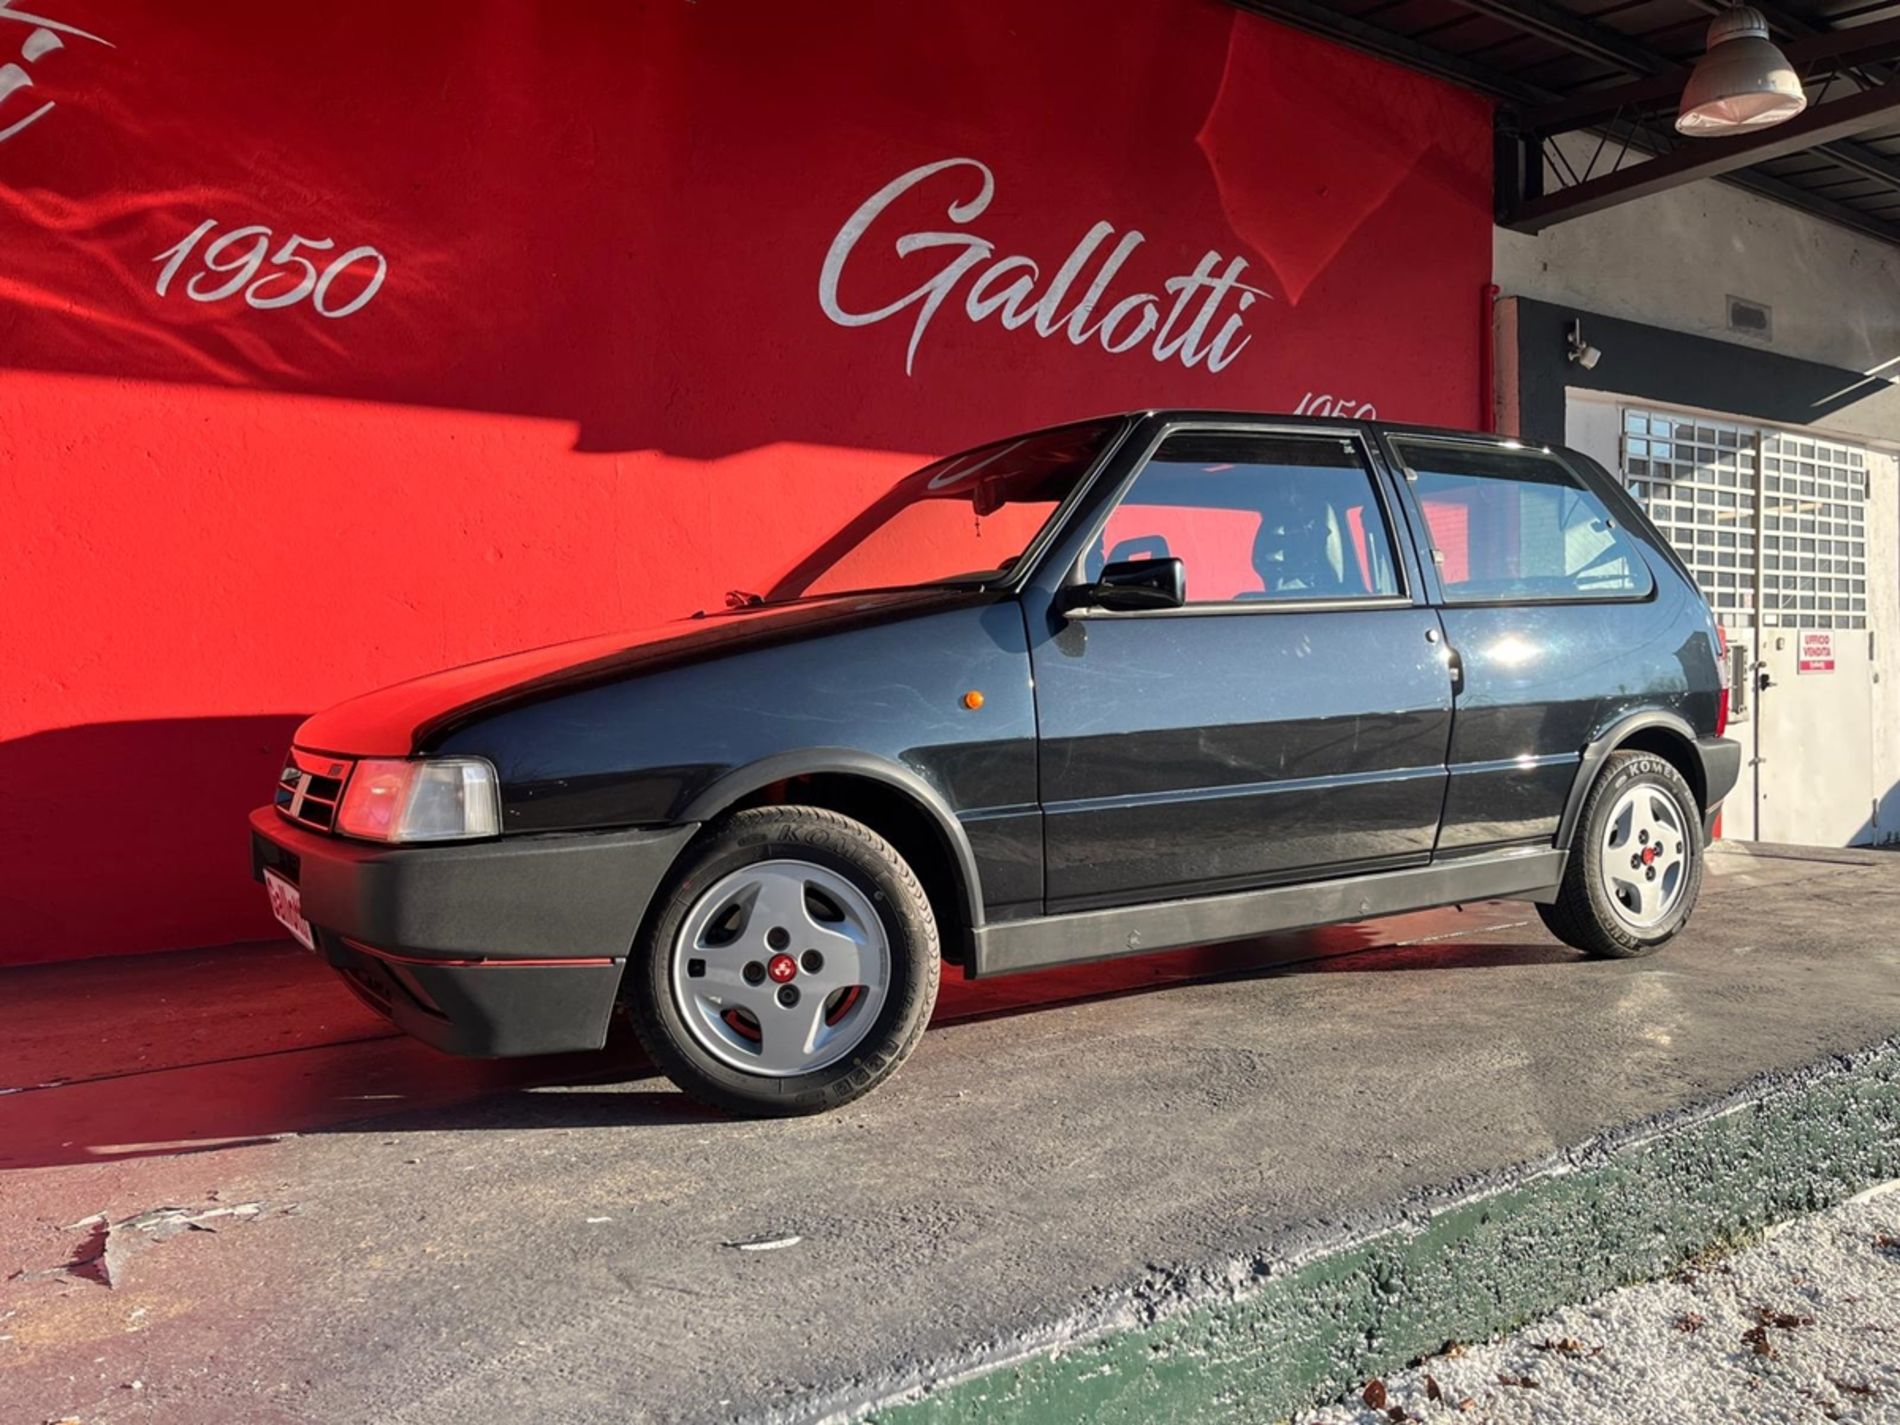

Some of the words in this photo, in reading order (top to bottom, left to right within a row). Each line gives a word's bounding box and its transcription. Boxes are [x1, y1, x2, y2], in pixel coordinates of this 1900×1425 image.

[152, 219, 387, 318] 1950
[819, 157, 1274, 376] Gallotti
[1629, 760, 1680, 782] KOMET
